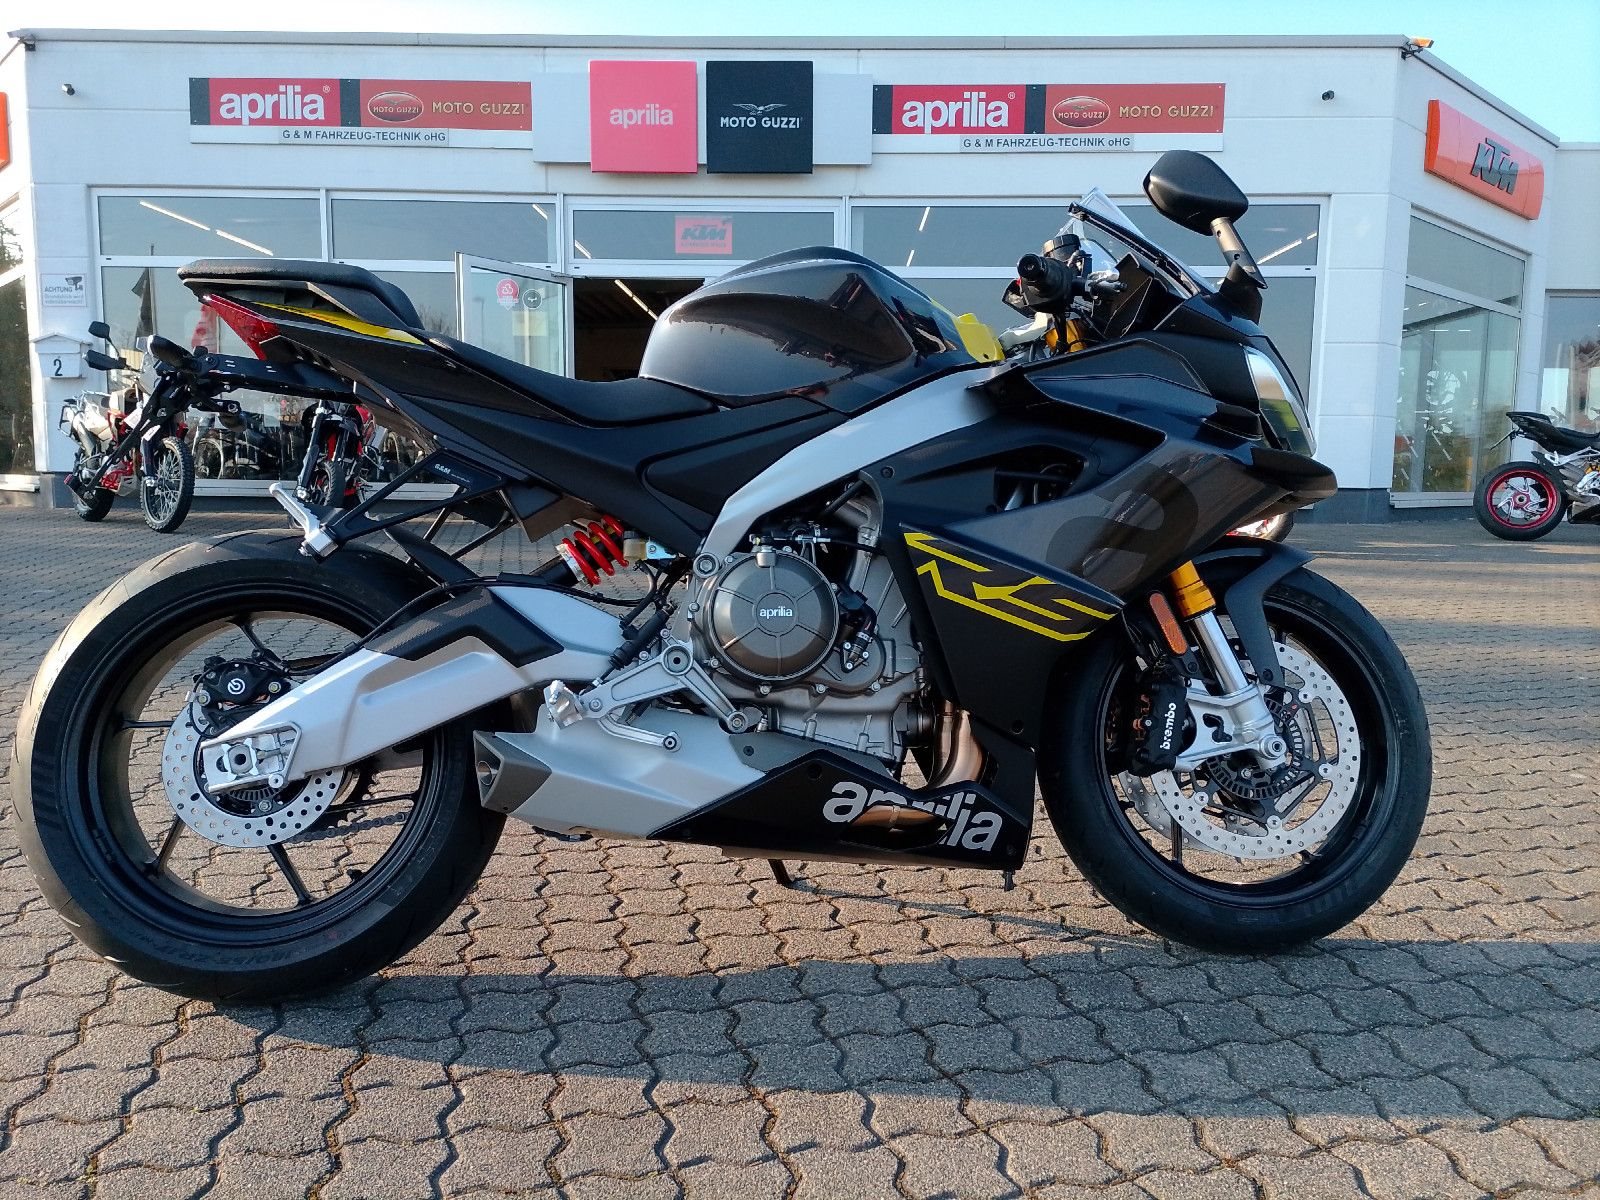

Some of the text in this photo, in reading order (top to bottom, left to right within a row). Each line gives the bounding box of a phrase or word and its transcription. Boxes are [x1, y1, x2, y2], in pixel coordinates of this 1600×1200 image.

[219, 85, 325, 125] aprilia
[373, 105, 419, 114] MOTO GUZZI
[432, 101, 525, 115] MOTO GUZZI
[1119, 105, 1214, 118] MOTO GUZZI
[609, 103, 673, 128] aprilia
[902, 92, 1009, 134] aprilia
[1058, 111, 1080, 119] MOTO
[720, 116, 800, 129] MOTO GUZZI
[282, 130, 446, 142] G & M FAHRZEUG-TECHNIK oHG
[963, 137, 1131, 148] G & M FAHRZEUG-TECHNIK oHG
[1470, 137, 1519, 196] KTM
[681, 224, 727, 240] KTM
[53, 358, 63, 377] 2
[759, 605, 793, 620] aprilia
[1160, 702, 1177, 750] brembo
